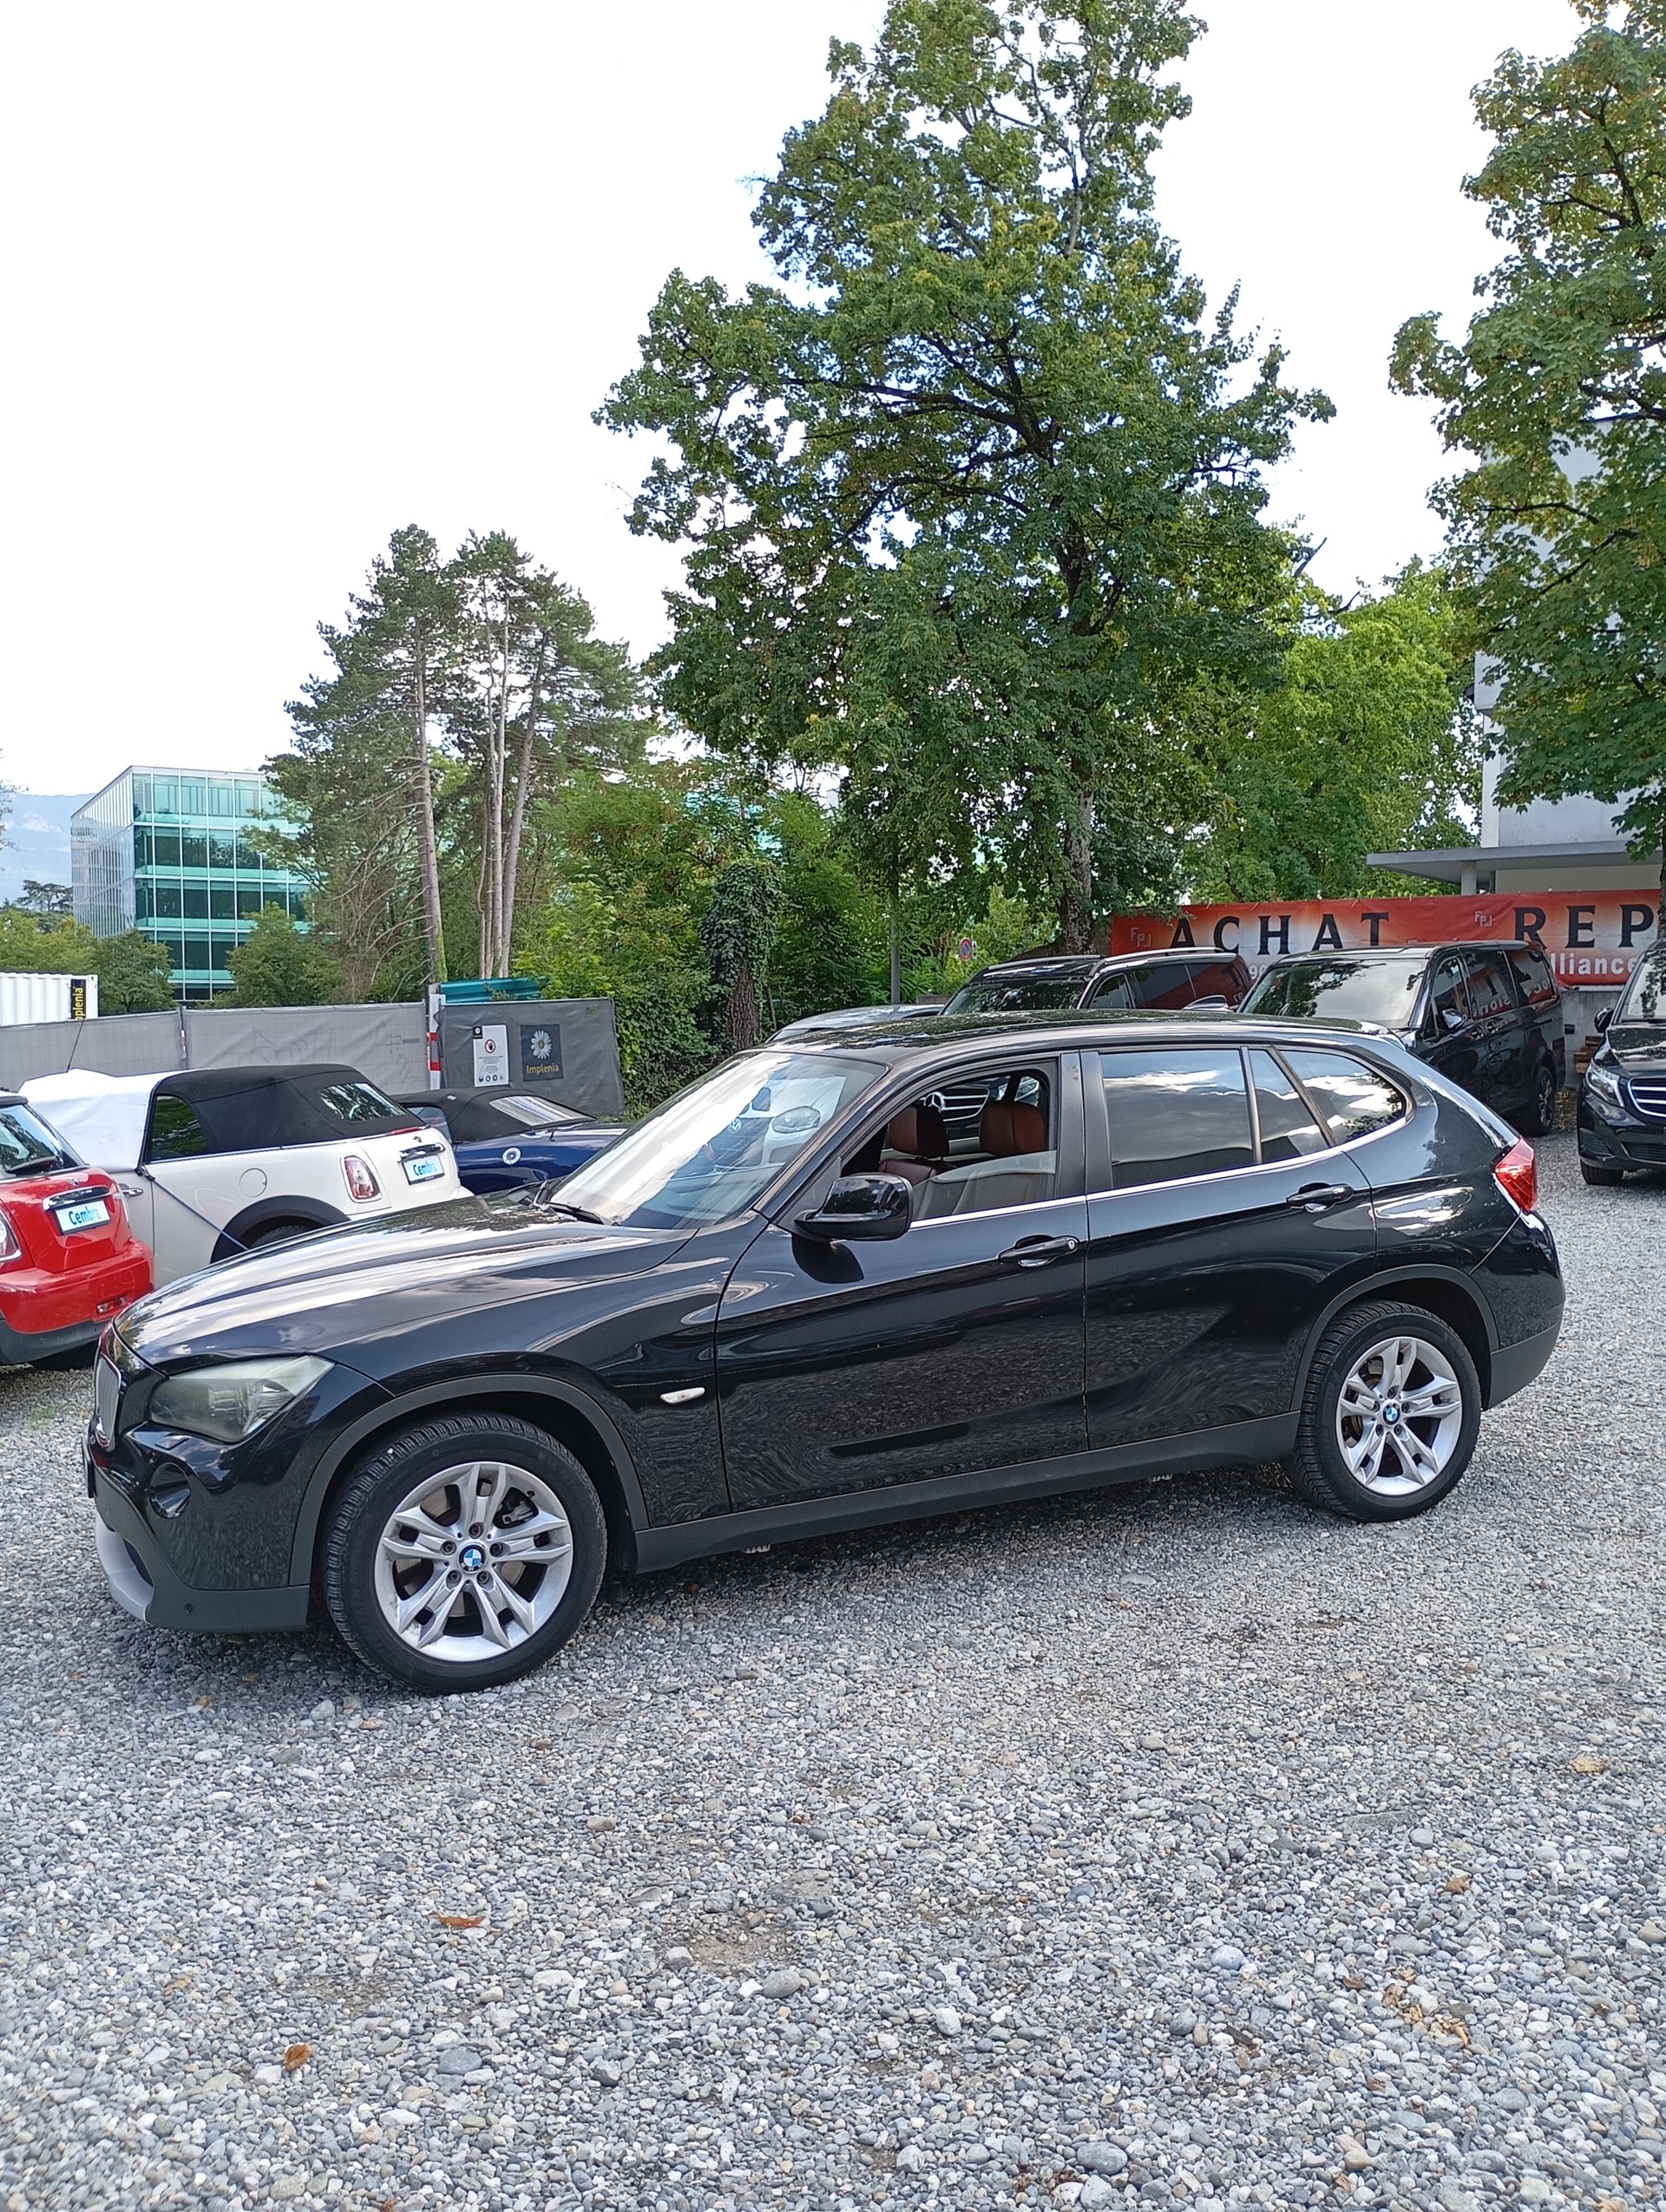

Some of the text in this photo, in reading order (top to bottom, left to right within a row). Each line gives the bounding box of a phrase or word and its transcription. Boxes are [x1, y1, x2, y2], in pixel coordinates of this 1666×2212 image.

[1166, 912, 1390, 955] ACHAT
[1512, 903, 1655, 949] REP
[527, 1063, 561, 1076] Implenia
[69, 1206, 102, 1225] Cembra
